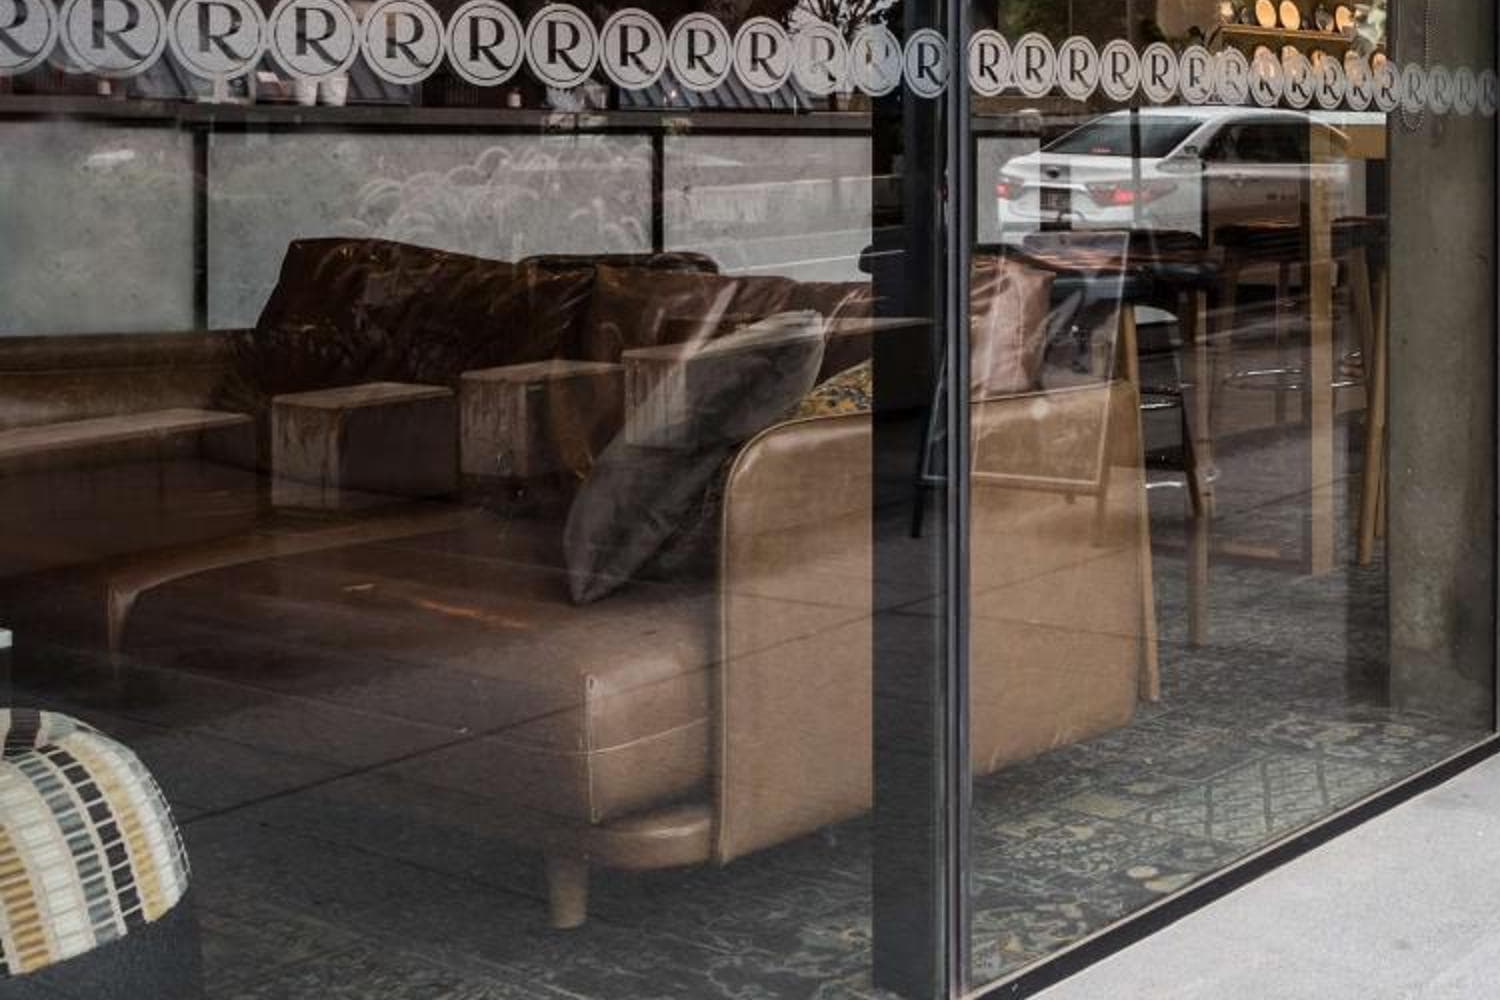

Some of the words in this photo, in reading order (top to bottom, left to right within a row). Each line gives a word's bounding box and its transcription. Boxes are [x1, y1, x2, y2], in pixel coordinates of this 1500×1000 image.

[198, 2, 250, 62] R
[295, 7, 344, 65] R
[385, 11, 431, 67] R
[469, 16, 511, 70] R
[547, 21, 584, 72] R
[620, 25, 654, 75] R
[687, 29, 720, 77] R
[751, 32, 779, 80] R
[810, 37, 836, 82] R
[918, 42, 943, 86] R
[979, 43, 999, 83] R
[1025, 46, 1045, 84] R
[1070, 49, 1091, 88] R
[1111, 51, 1132, 90] R
[1152, 54, 1171, 92] R
[1189, 57, 1208, 95] R
[1323, 64, 1340, 100] R
